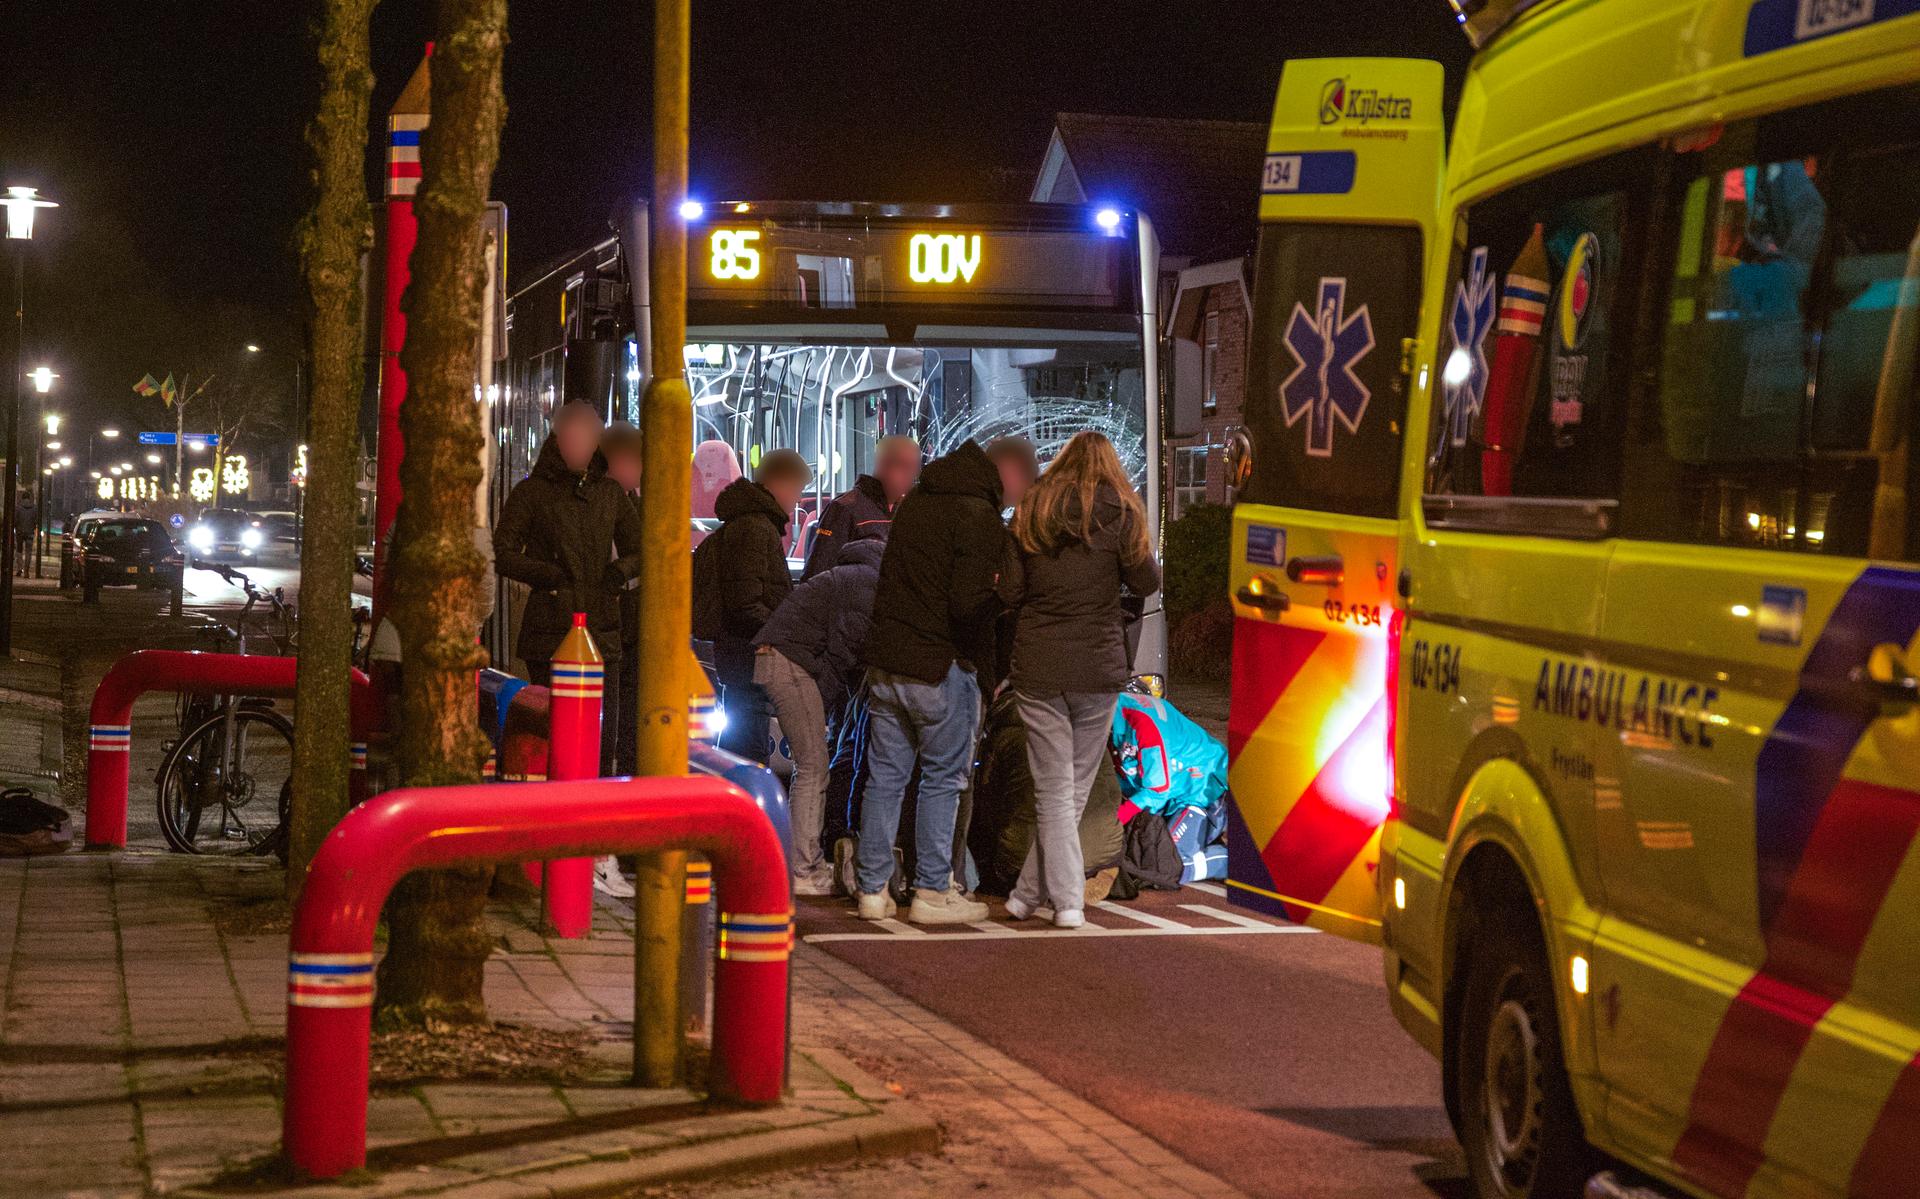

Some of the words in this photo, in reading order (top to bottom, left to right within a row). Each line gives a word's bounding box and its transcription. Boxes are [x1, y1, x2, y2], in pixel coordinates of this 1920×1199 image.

[1345, 88, 1412, 124] Kijlstra
[710, 229, 760, 280] 85
[1324, 600, 1382, 627] 02-134
[1412, 639, 1462, 693] 02-134
[1534, 659, 1720, 748] AMBULANCE
